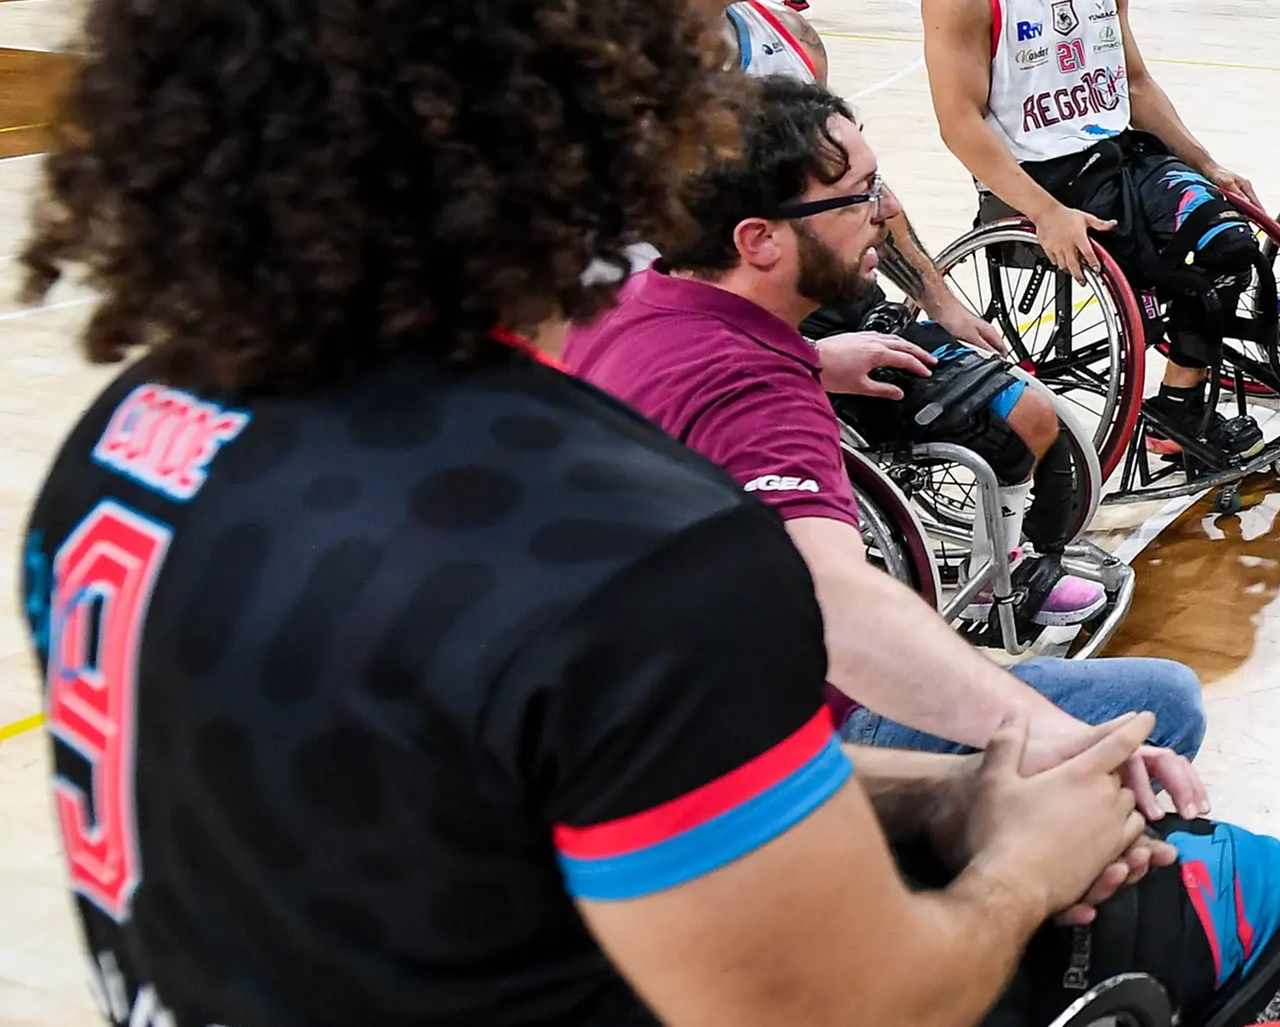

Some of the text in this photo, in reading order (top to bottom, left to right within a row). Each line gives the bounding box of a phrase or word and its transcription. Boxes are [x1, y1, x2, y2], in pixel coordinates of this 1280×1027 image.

[1056, 38, 1087, 74] 21
[1023, 69, 1120, 132] REGGIO
[46, 497, 174, 920] 9
